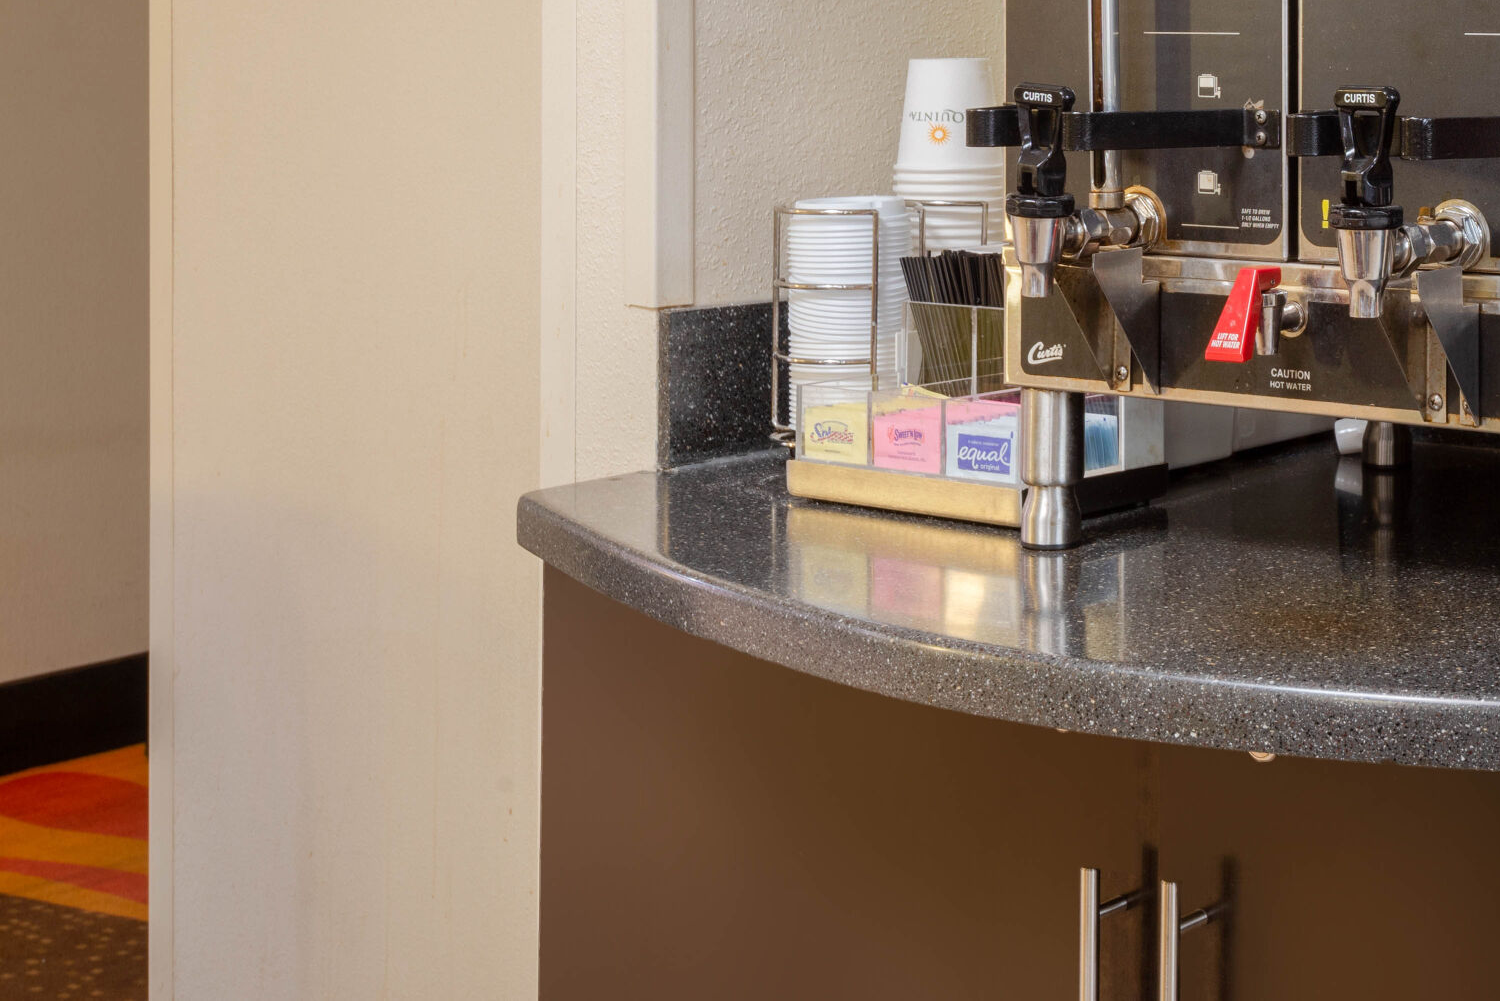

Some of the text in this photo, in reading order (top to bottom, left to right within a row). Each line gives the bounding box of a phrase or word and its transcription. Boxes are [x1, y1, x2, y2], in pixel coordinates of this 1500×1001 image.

[1023, 90, 1052, 103] CURTIS
[1344, 93, 1376, 104] CURTIS
[912, 109, 964, 123] QUINTA
[1229, 333, 1239, 341] FOR
[1223, 341, 1240, 349] WATER
[1028, 342, 1063, 364] Curtis
[1271, 368, 1310, 380] CAUTION
[1270, 381, 1312, 391] HOT WATER
[957, 442, 1010, 469] equal
